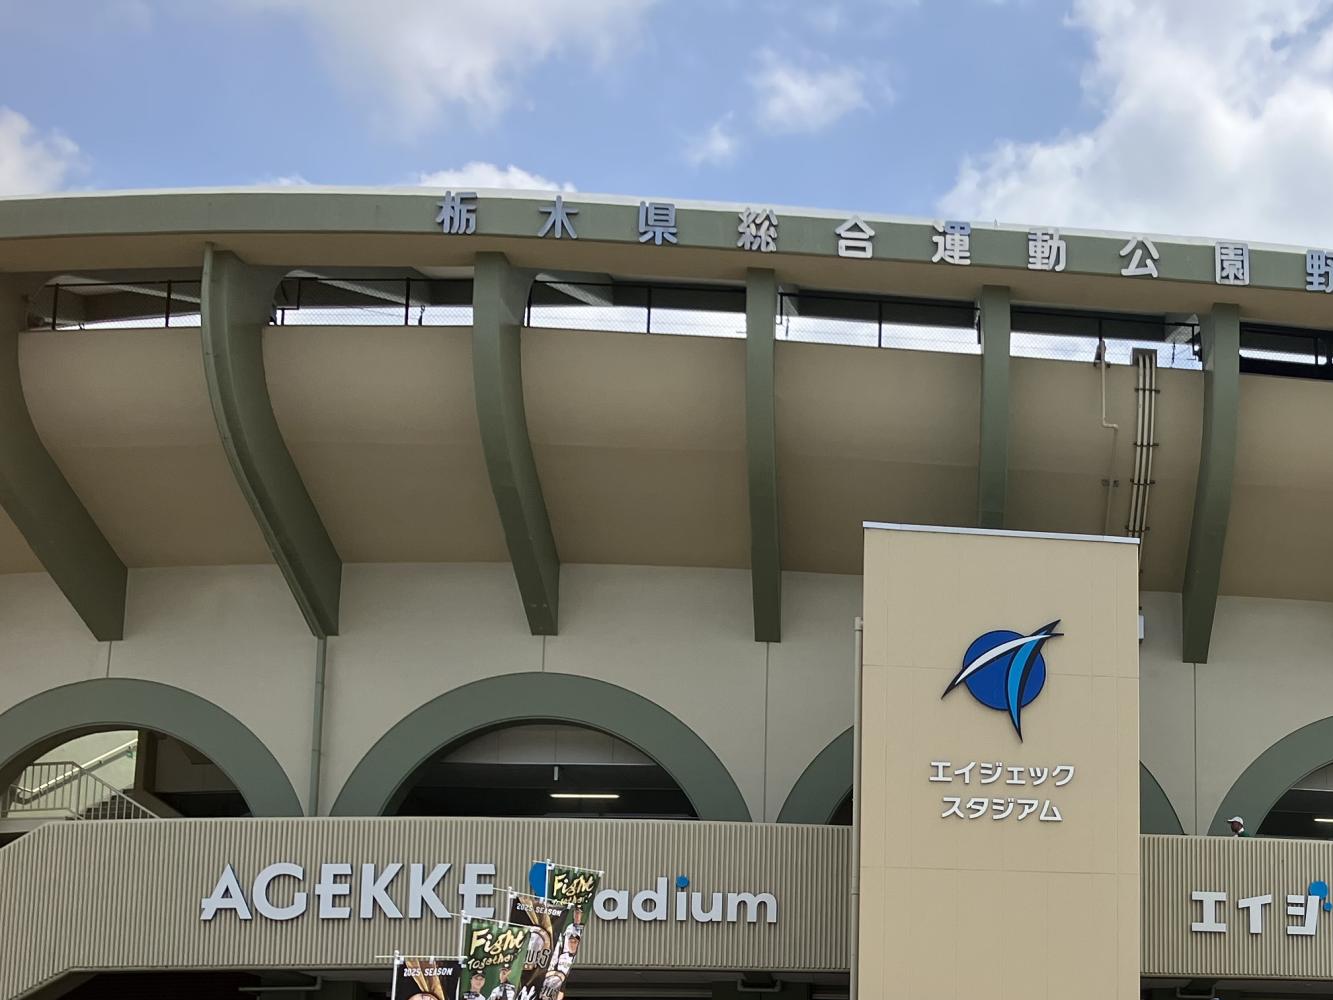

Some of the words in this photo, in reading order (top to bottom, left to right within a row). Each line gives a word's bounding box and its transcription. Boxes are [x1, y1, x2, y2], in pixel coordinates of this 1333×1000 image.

[929, 761, 1075, 786] エイジェック
[941, 797, 1063, 821] スタジアム
[200, 862, 496, 921] AGEKKE
[469, 928, 524, 955] Fight
[403, 968, 421, 977] 2025
[424, 968, 453, 977] SEASON
